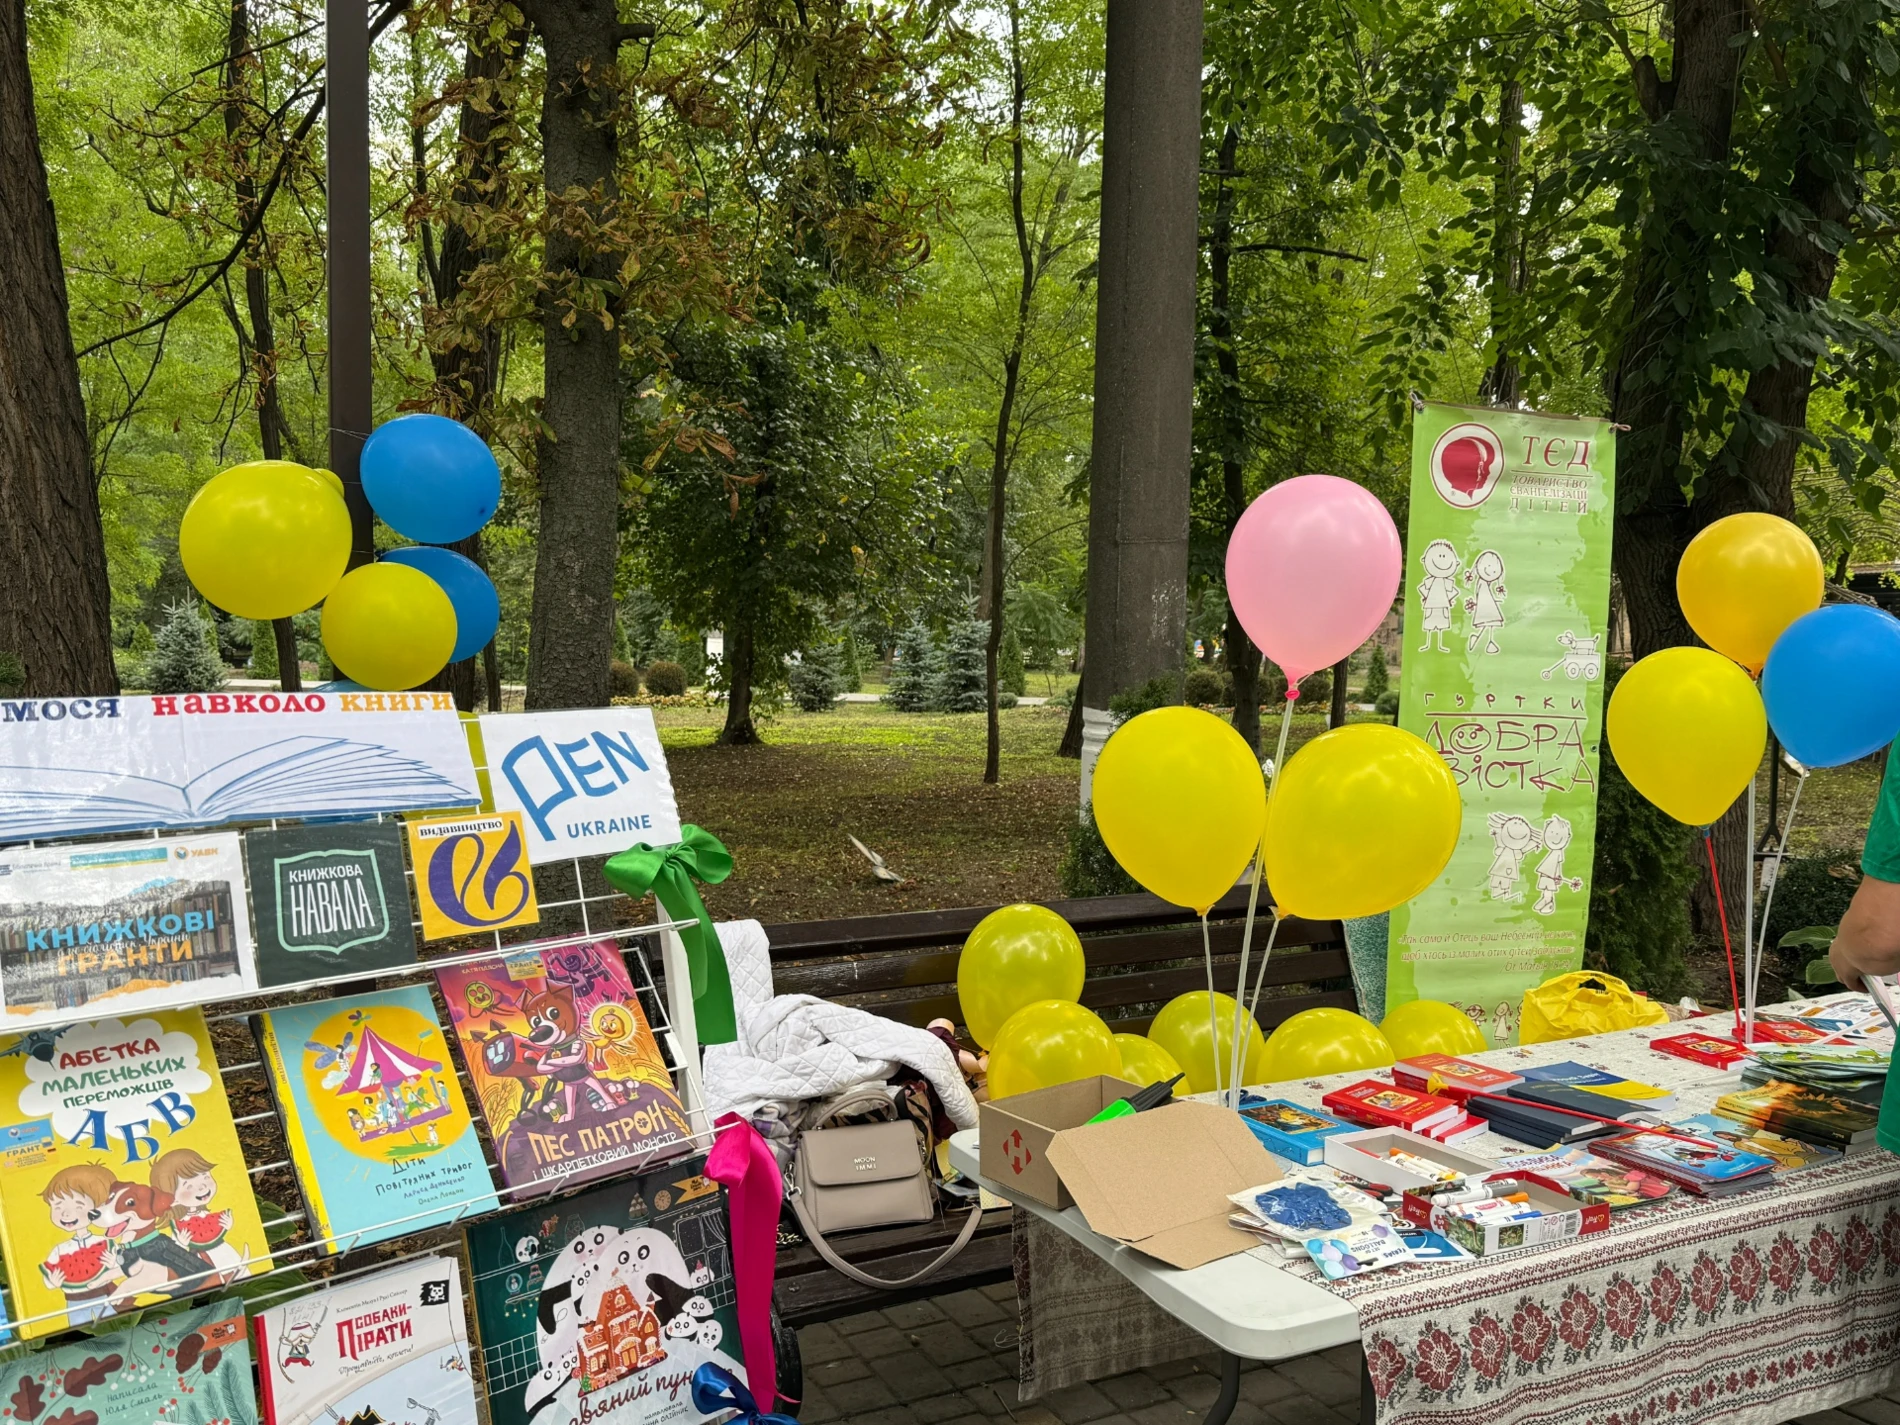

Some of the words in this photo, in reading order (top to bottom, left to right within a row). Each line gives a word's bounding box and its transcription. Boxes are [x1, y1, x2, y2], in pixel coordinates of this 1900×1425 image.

[1522, 435, 1591, 472] ТЄД
[1511, 474, 1588, 490] ТОВАРИСТВО
[1509, 497, 1588, 514] ДІТЕЙ
[501, 731, 650, 842] PEN
[419, 820, 503, 838] видавництво
[567, 814, 652, 839] UKRAINE
[288, 863, 364, 884] КНИЖКОВА
[290, 877, 376, 938] НАВАЛА
[26, 909, 215, 952] КНИЖКОВІ
[57, 941, 194, 976] ГРАНТИ
[60, 1038, 160, 1070] АБЕТКА
[42, 1056, 186, 1096] МАЛЕНЬКИХ
[63, 1079, 174, 1108] ПЕРЕМОЖЦІВ
[527, 1130, 575, 1165] ПЕС
[579, 1098, 668, 1152] ПАТРОН
[6, 1145, 40, 1158] ГРАНТ
[541, 1143, 630, 1178] ШКАРПЕТКОВИЙ
[633, 1131, 678, 1152] МОНСТР
[1350, 1239, 1387, 1253] BALLOONS
